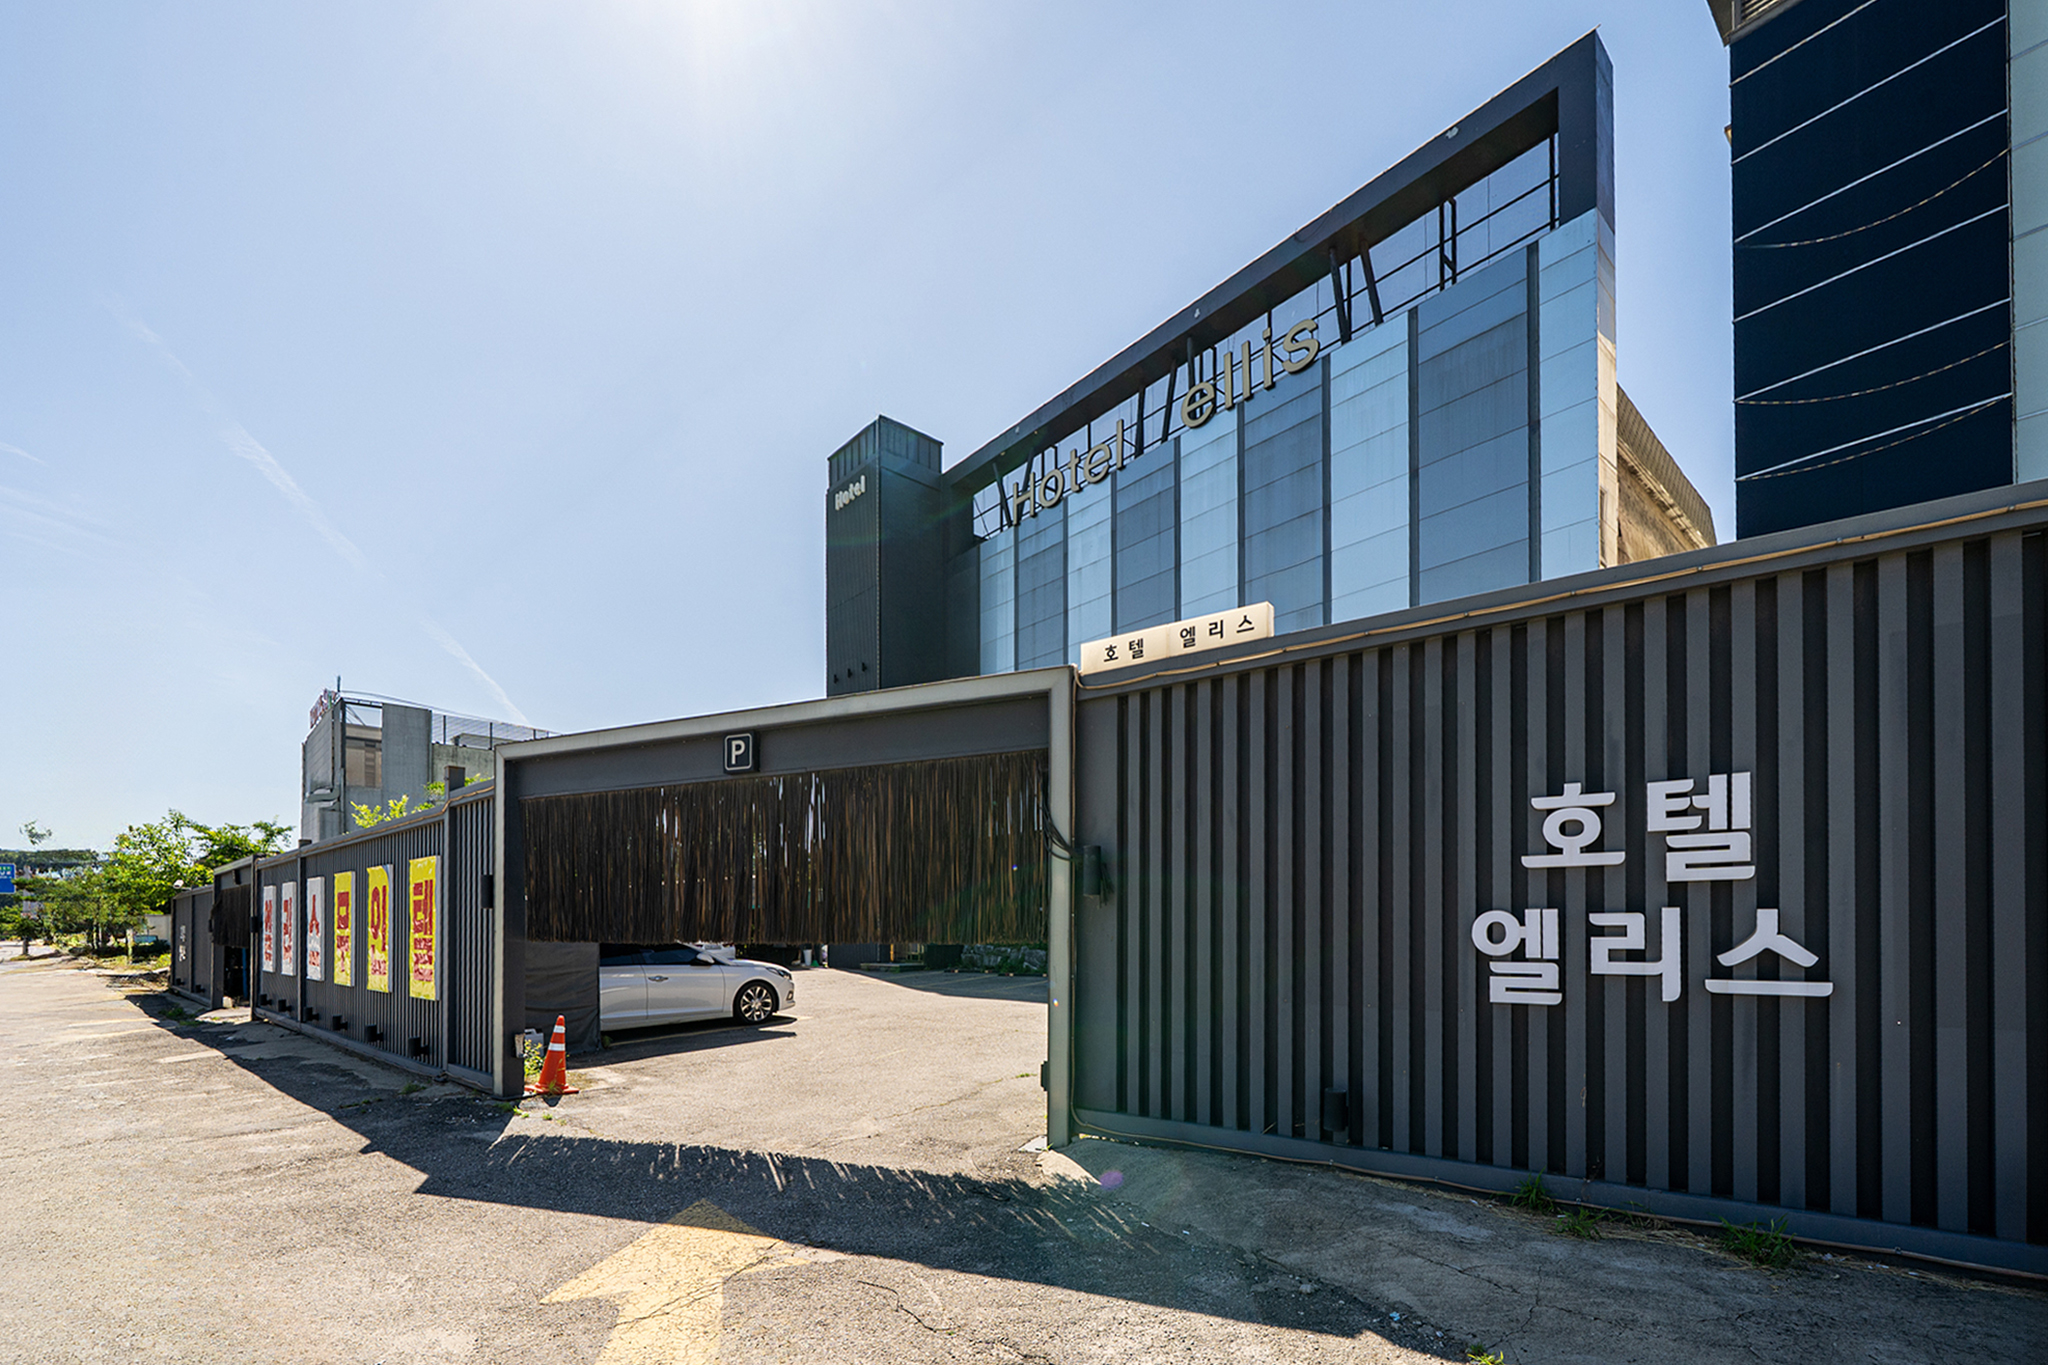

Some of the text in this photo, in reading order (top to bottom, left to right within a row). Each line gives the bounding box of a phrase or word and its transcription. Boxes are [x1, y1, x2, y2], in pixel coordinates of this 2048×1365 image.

[1012, 318, 1320, 526] Hotel ellis
[835, 475, 866, 511] Hotel
[1103, 615, 1255, 663] 호텔 엘리스
[731, 739, 746, 765] P
[1520, 771, 1756, 882] 호텔
[1471, 907, 1834, 1005] 엘리스
